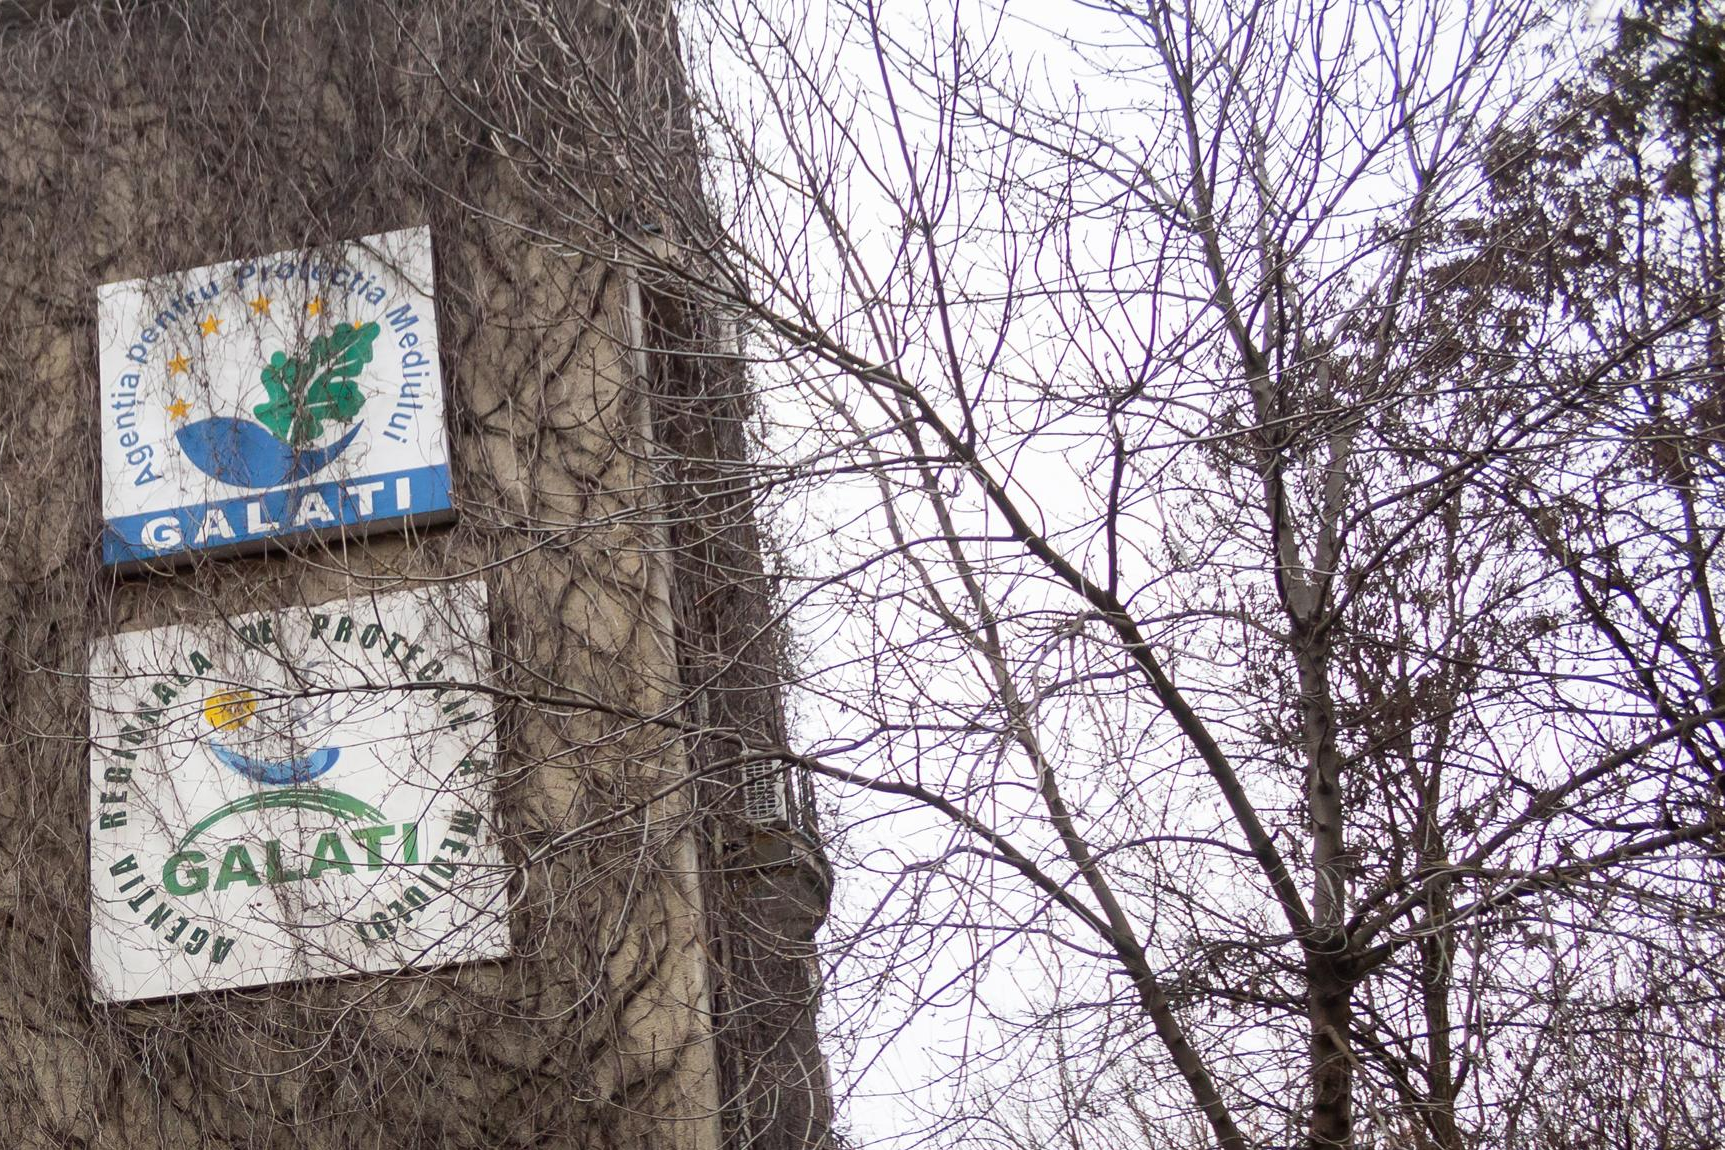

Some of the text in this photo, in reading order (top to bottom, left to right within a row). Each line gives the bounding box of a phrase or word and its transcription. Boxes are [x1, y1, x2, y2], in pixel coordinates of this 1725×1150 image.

[126, 279, 220, 367] pentru
[383, 303, 431, 445] Mediului
[140, 476, 412, 552] GALATI
[162, 822, 419, 897] GALATI
[109, 853, 235, 965] AGENTIA
